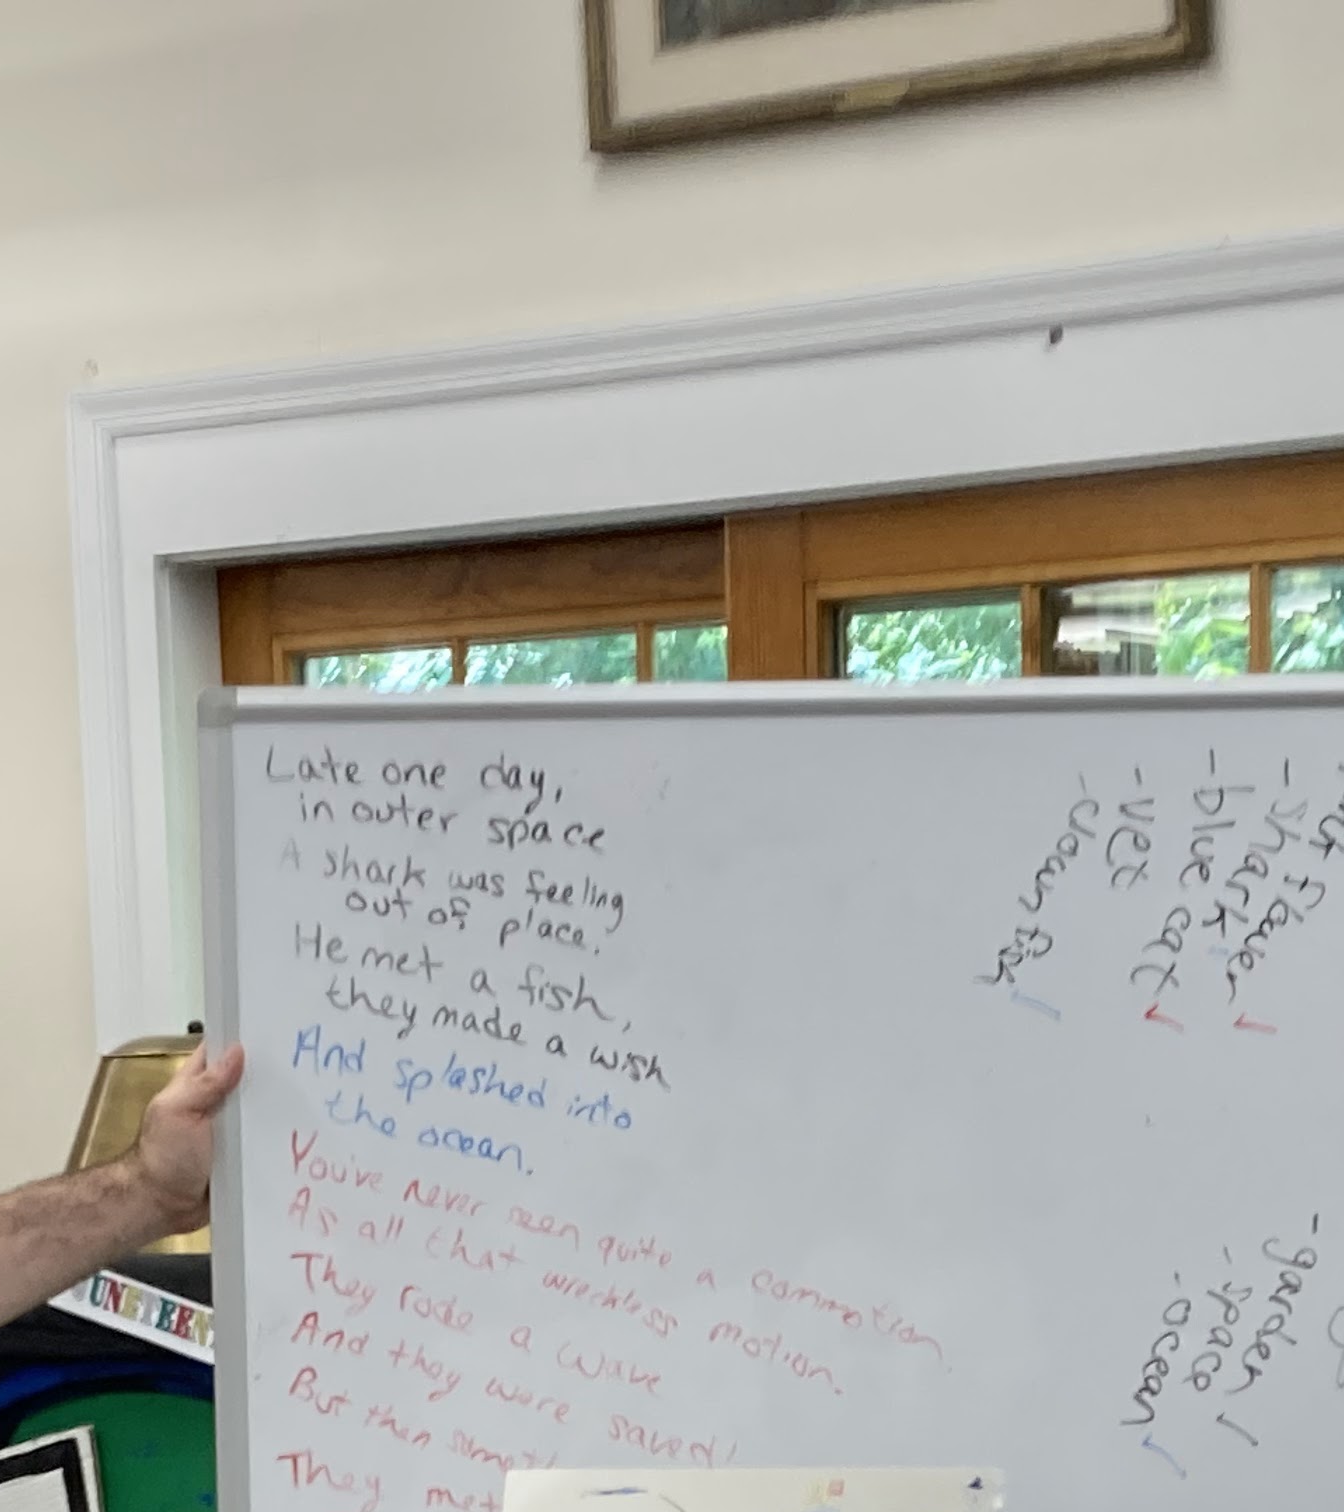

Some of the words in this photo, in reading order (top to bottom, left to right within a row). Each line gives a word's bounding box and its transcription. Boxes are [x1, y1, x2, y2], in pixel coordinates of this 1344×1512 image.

[267, 747, 360, 784] Late
[383, 759, 446, 789] one
[481, 752, 563, 814] day,
[299, 793, 334, 822] in
[352, 794, 459, 833] outer
[488, 813, 606, 854] space
[281, 840, 301, 871] A
[324, 846, 426, 889] shark
[449, 870, 505, 896] was
[526, 868, 624, 934] feeling
[346, 889, 412, 921] out
[428, 898, 472, 930] of
[296, 923, 348, 964] He
[362, 945, 443, 981] met
[471, 968, 495, 996] a
[1129, 905, 1193, 995] cat
[325, 977, 417, 1039] they
[433, 1003, 528, 1045] made
[547, 1035, 566, 1057] a
[590, 1043, 672, 1094] wish
[293, 1023, 365, 1073] And
[394, 1052, 547, 1103] splashed
[567, 1091, 631, 1130] into
[326, 1090, 396, 1138] the
[417, 1126, 535, 1175] ocean.
[291, 1129, 384, 1193] You've
[404, 1179, 488, 1216] never
[597, 1235, 672, 1268] quite
[696, 1267, 717, 1291] a
[358, 1212, 404, 1244] all
[425, 1227, 526, 1271] that
[72, 1273, 216, 1348] UNETEEN
[290, 1252, 376, 1317] They
[510, 1325, 533, 1353] a
[290, 1311, 369, 1356] And
[289, 1366, 350, 1416] But
